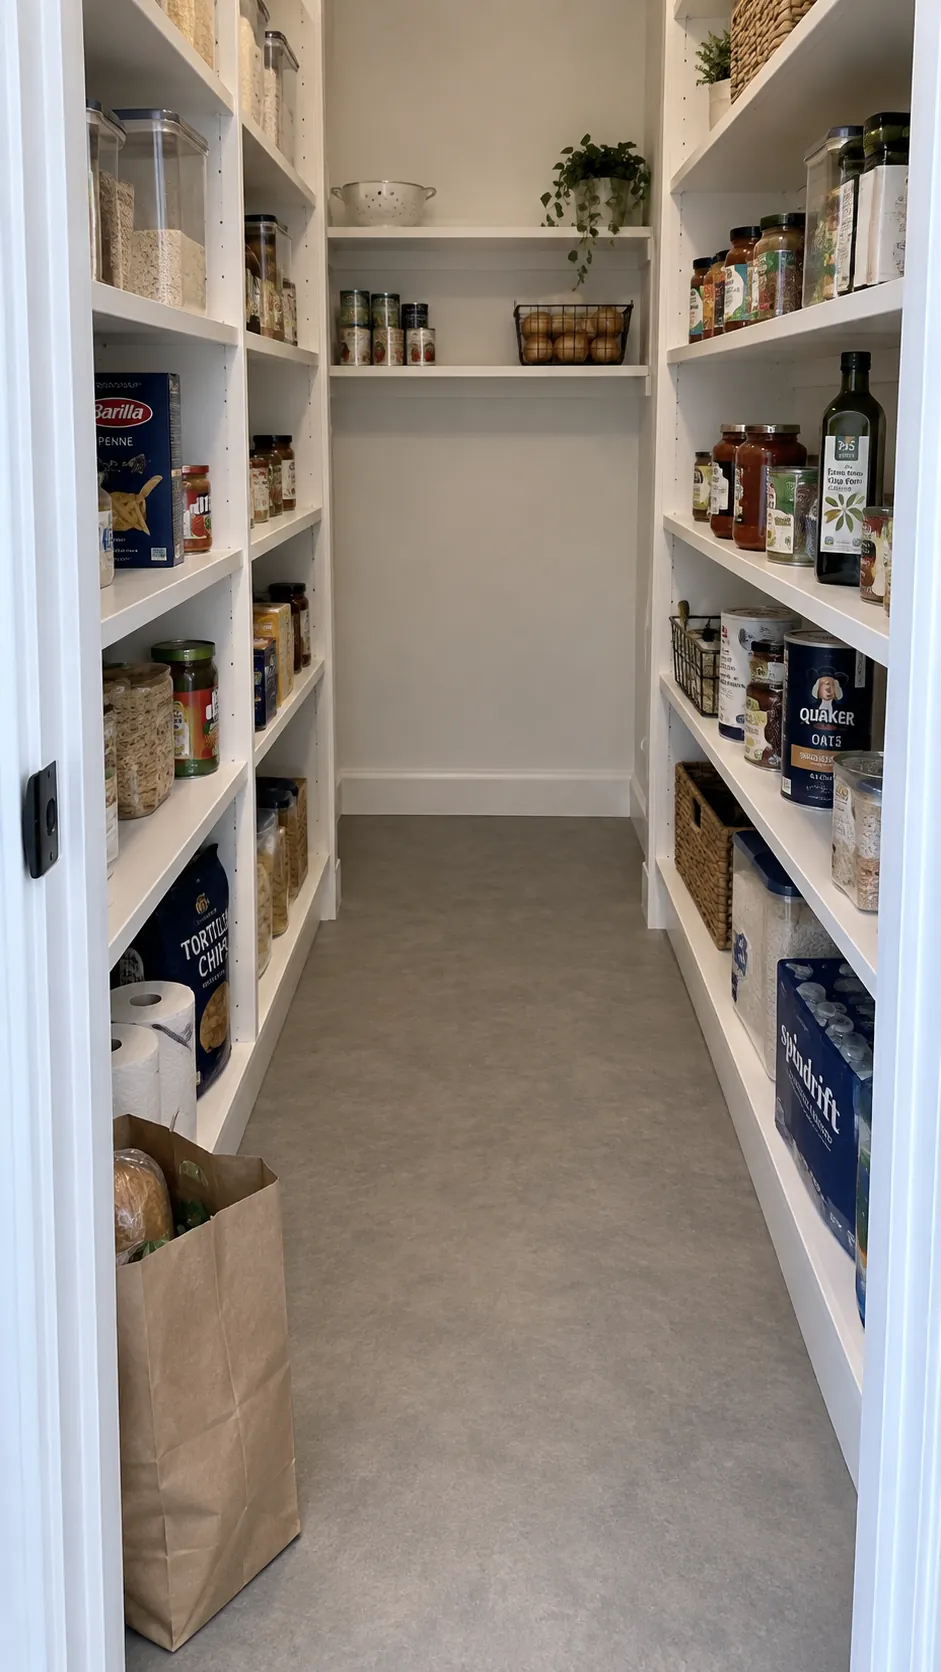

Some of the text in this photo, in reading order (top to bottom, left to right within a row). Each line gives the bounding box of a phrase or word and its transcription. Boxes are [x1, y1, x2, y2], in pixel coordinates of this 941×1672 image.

[95, 404, 144, 419] Barilla
[98, 436, 134, 446] PENNE
[800, 707, 855, 726] QUAKER
[811, 734, 842, 747] OATS
[198, 936, 229, 977] CHIP
[781, 1024, 841, 1134] spindrift
